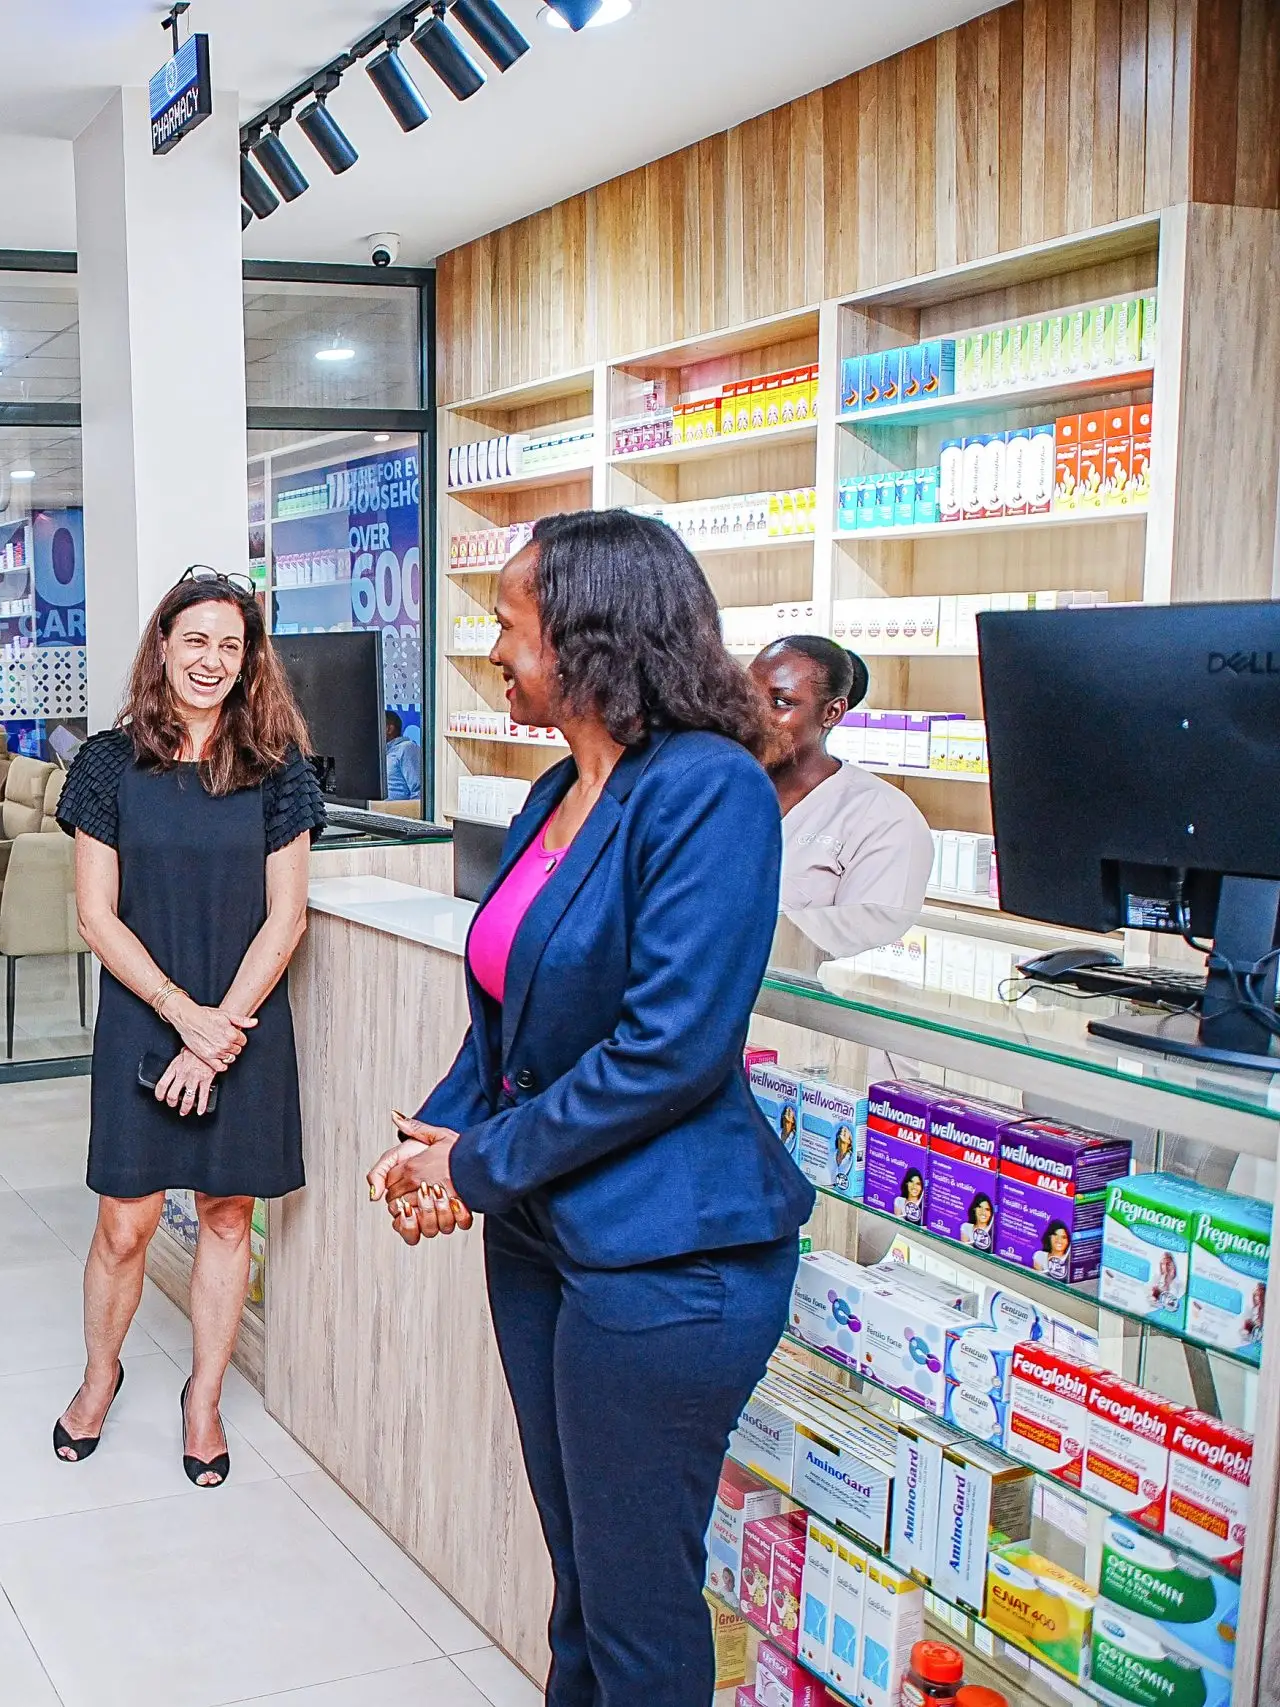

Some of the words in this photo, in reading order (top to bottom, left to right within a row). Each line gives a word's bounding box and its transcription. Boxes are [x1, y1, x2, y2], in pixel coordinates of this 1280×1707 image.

[152, 87, 199, 150] PHARMACY
[378, 460, 402, 481] FOR
[349, 522, 390, 553] OVER
[1208, 651, 1280, 674] DELL
[751, 1072, 798, 1097] wellwoman
[802, 1090, 855, 1118] wellwoman
[869, 1101, 926, 1130] wellwoman
[897, 1128, 923, 1145] MAX
[931, 1122, 995, 1154] wellwoman
[963, 1150, 992, 1169] MAX
[1001, 1144, 1073, 1179] wellwoman
[1037, 1175, 1069, 1195] MAX
[1108, 1186, 1187, 1233] Pregnacare
[1000, 1302, 1029, 1320] Centrum
[960, 1342, 988, 1361] Centrum
[1014, 1353, 1088, 1397] Feroglobin
[960, 1389, 989, 1408] Centrum
[1090, 1388, 1167, 1437] Feroglobin
[806, 1451, 871, 1497] AminoGard
[904, 1448, 919, 1544] AminoGard
[949, 1474, 966, 1574] AminoGard
[1107, 1555, 1185, 1607] OSTEOMIN
[992, 1585, 1031, 1616] ENAT
[1032, 1610, 1057, 1631] 400
[1098, 1641, 1175, 1698] OSTEOMIN
